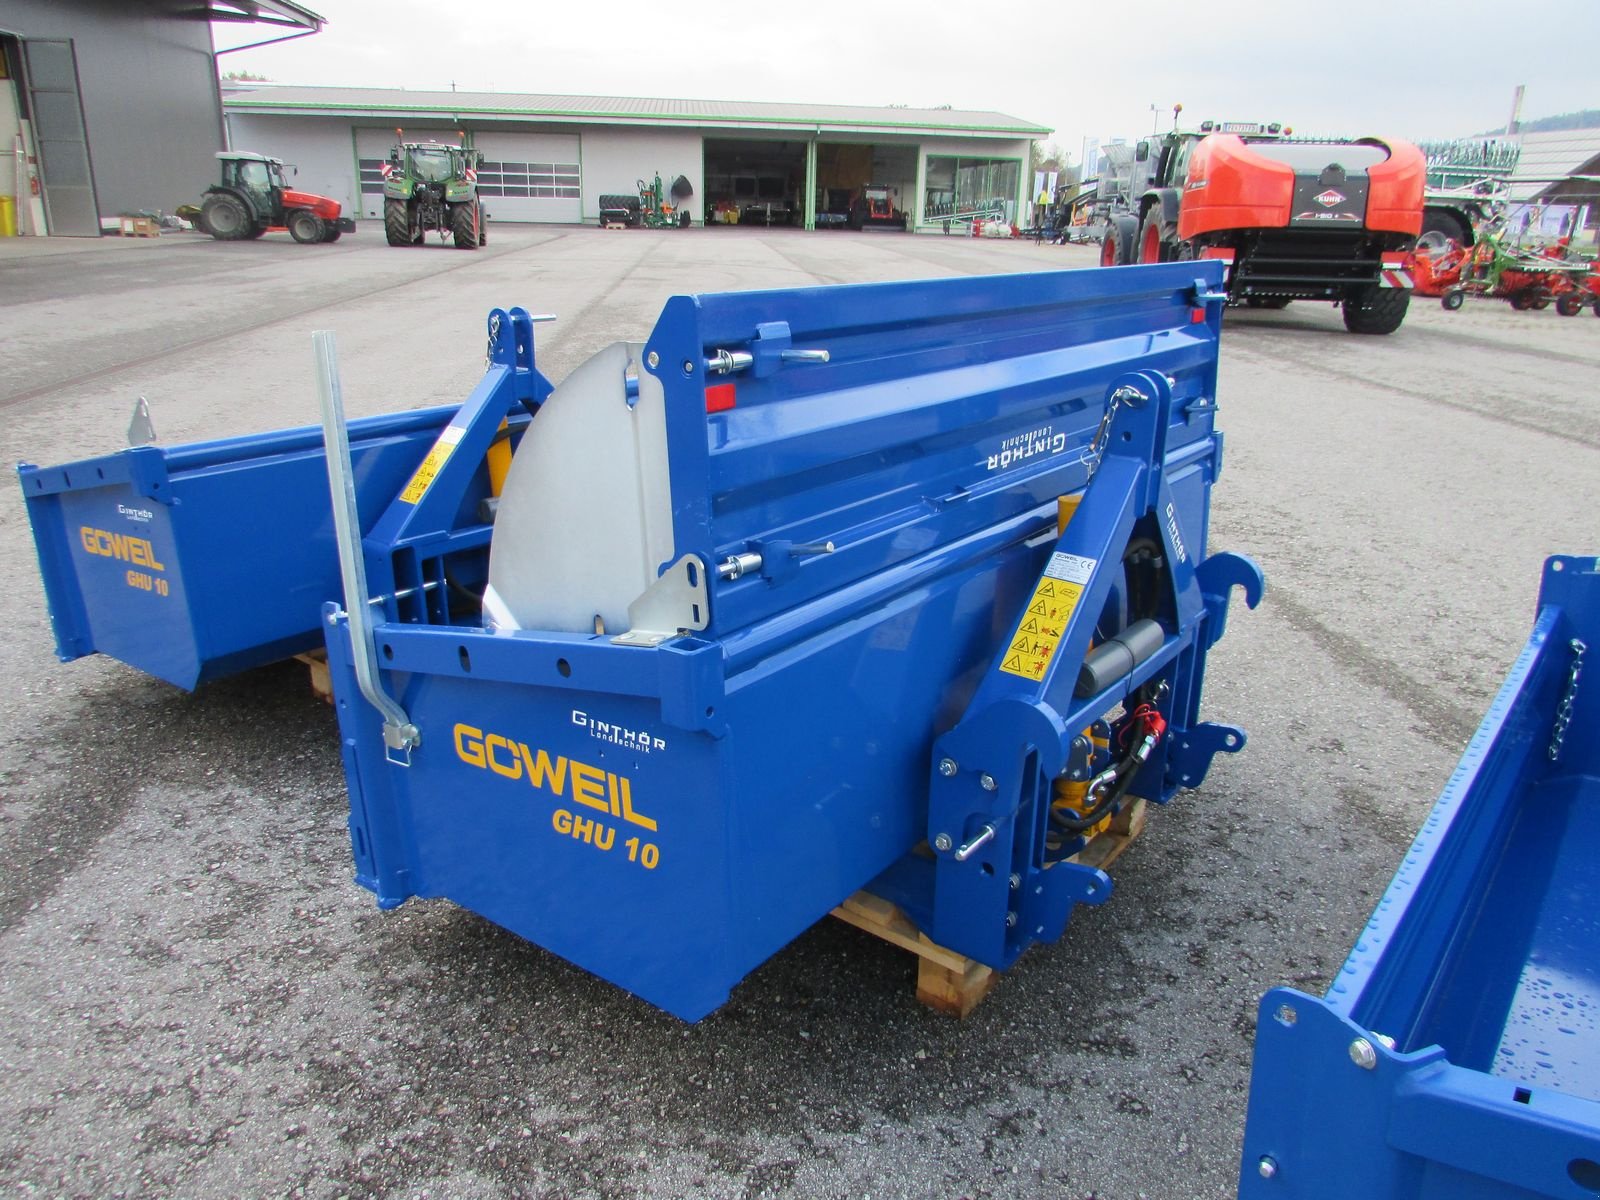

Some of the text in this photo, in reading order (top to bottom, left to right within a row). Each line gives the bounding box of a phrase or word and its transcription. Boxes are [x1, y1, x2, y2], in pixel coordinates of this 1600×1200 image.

[1318, 195, 1341, 203] KUHN
[126, 570, 169, 597] GHU 10
[572, 710, 667, 751] GINTHÖR
[552, 808, 660, 870] GHU 10
